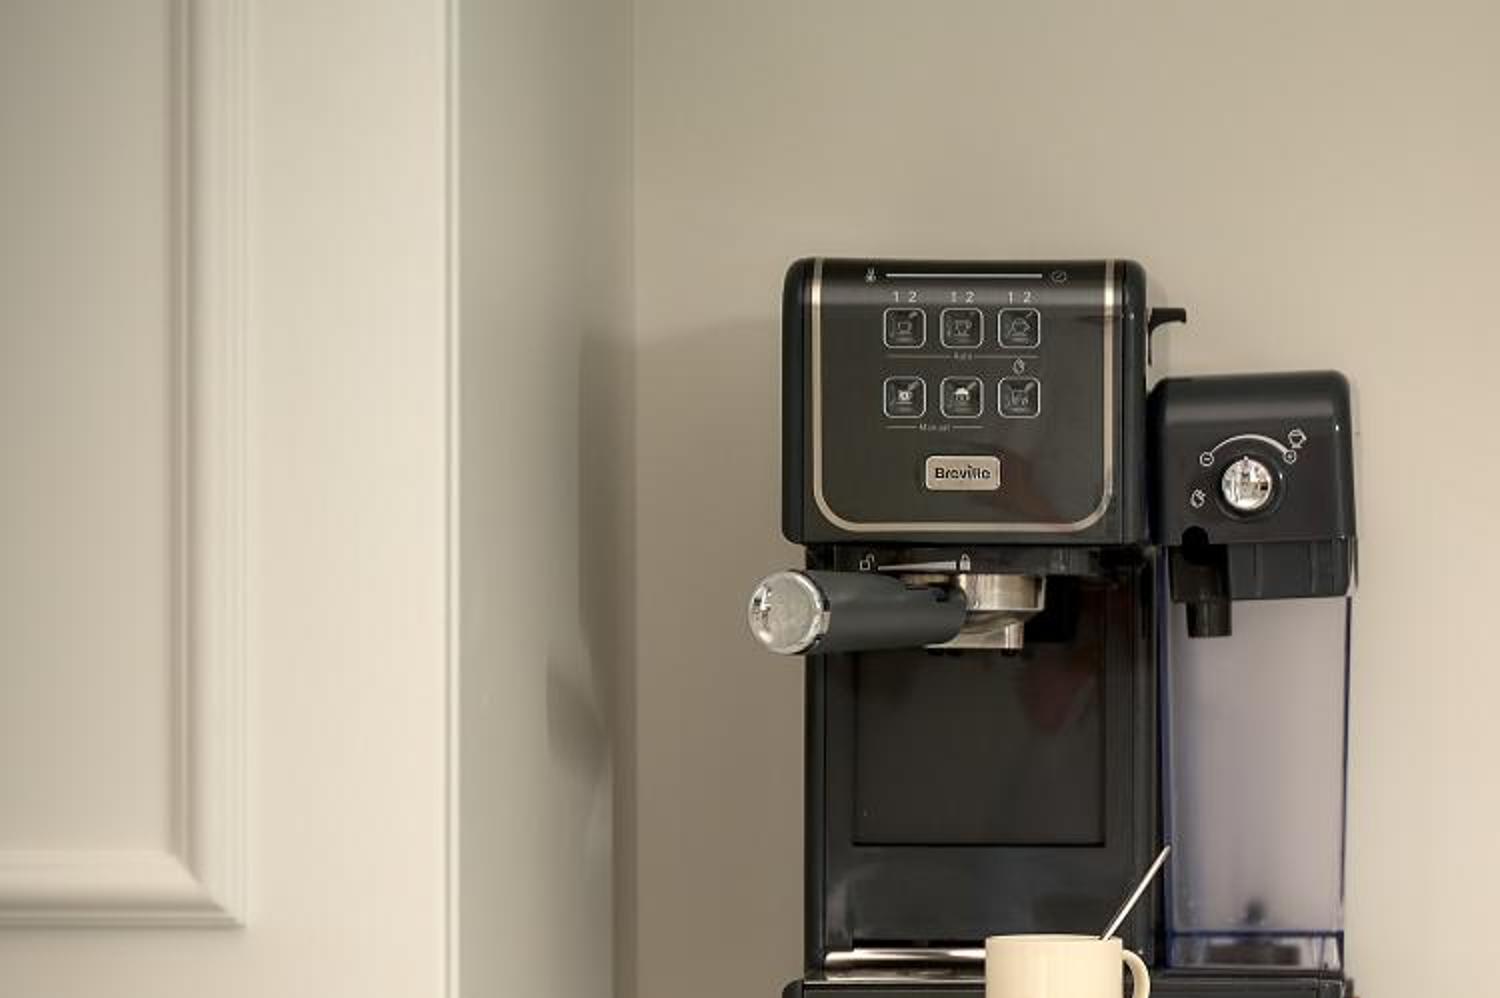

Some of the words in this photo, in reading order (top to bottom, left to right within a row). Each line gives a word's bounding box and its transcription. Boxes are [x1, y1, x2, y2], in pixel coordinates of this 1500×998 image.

[893, 291, 900, 303] 1
[908, 291, 918, 303] 2
[965, 291, 976, 304] 2
[1008, 291, 1014, 304] 1
[1023, 291, 1032, 303] 2
[935, 464, 991, 479] Breville
